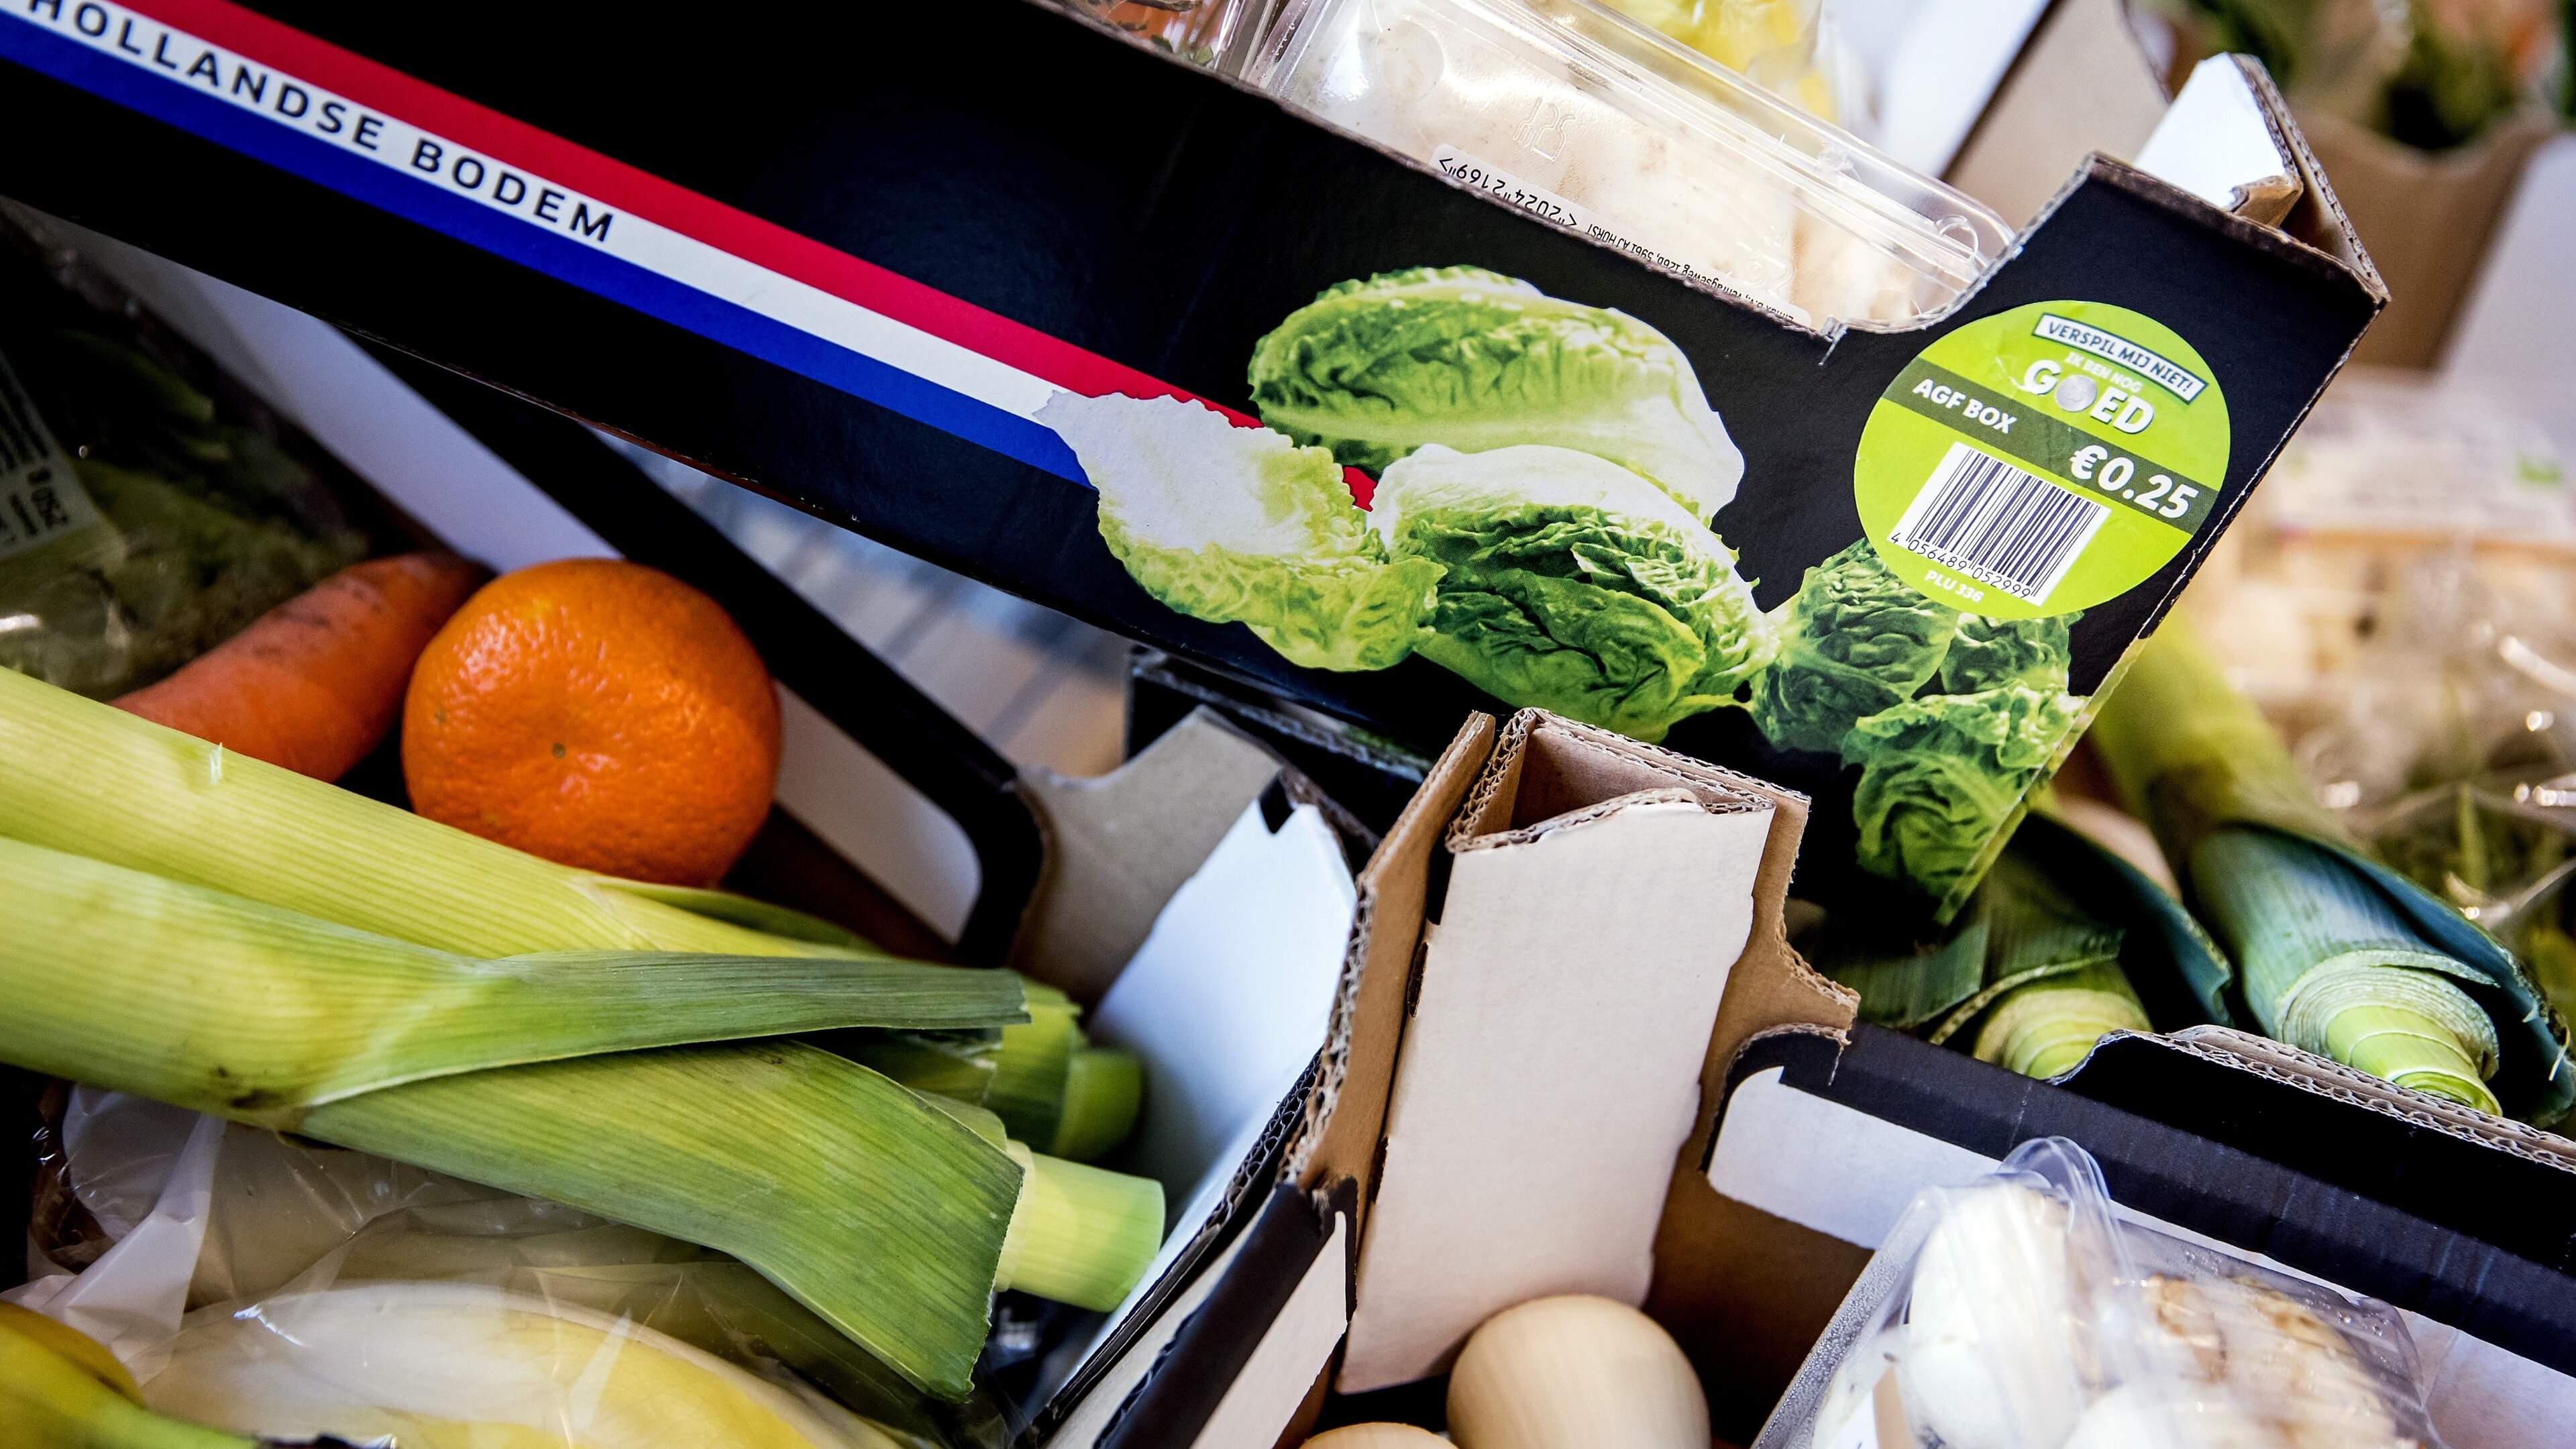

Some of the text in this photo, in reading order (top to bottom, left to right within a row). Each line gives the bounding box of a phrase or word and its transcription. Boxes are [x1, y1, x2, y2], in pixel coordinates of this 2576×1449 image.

[28, 0, 614, 244] HOLLANDSE BODEM
[1585, 223, 1617, 244] HORST
[1616, 237, 1631, 250] AJ
[1631, 244, 1654, 262] 5961
[2049, 321, 2194, 392] VERSPIL MIJ NIET!
[2064, 351, 2143, 393] IK BEN NOG
[1912, 378, 2019, 435] AGF BOX
[2069, 444, 2200, 519] €0.25
[1890, 532, 2031, 599] 4 056489 052999
[1923, 569, 1985, 603] PLU 336
